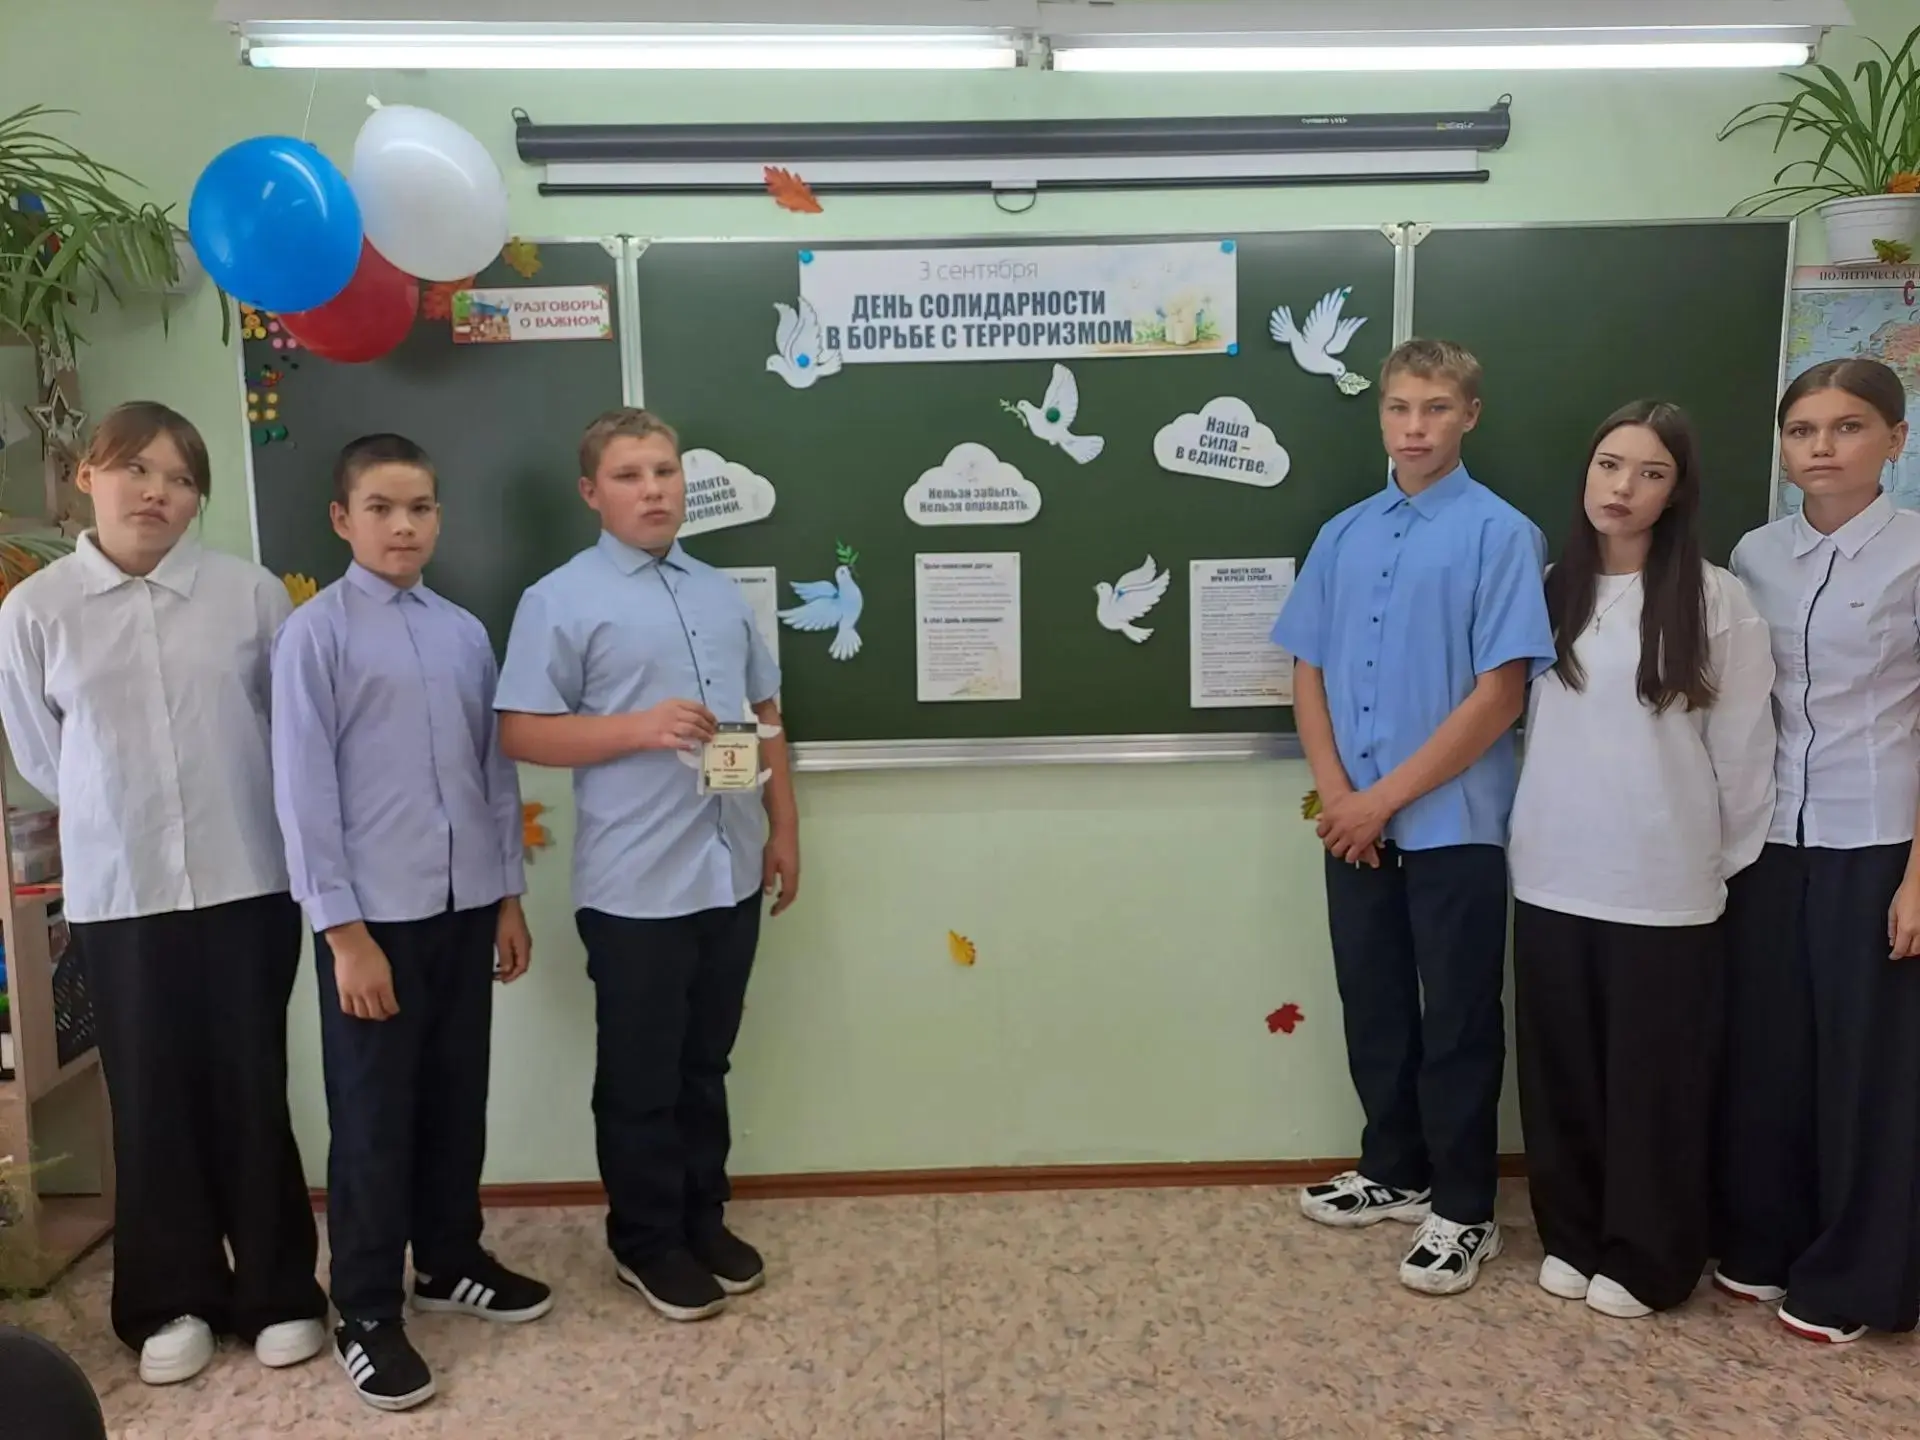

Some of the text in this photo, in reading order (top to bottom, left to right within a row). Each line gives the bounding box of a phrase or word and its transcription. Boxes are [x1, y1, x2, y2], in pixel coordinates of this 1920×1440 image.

[918, 259, 1039, 281] 3 сентября
[1820, 270, 1916, 281] ПОЛИТИЧЕСКАЯ
[514, 300, 603, 312] РАЗГОВОРЫ
[852, 290, 1105, 322] ДЕНЬ СОЛИДАРНОСТИ
[520, 316, 600, 328] О ВАЖНОМ
[826, 319, 1132, 350] В БОРЬБЕ С ТЕРРОРИЗМОМ
[1206, 416, 1250, 438] Наша
[1200, 434, 1238, 453] сила
[1175, 446, 1268, 475] в единстве.
[687, 475, 730, 493] амять
[686, 487, 737, 507] ильнее
[928, 488, 972, 499] Нельзя
[920, 502, 962, 513] Нельзя
[723, 750, 736, 767] 3
